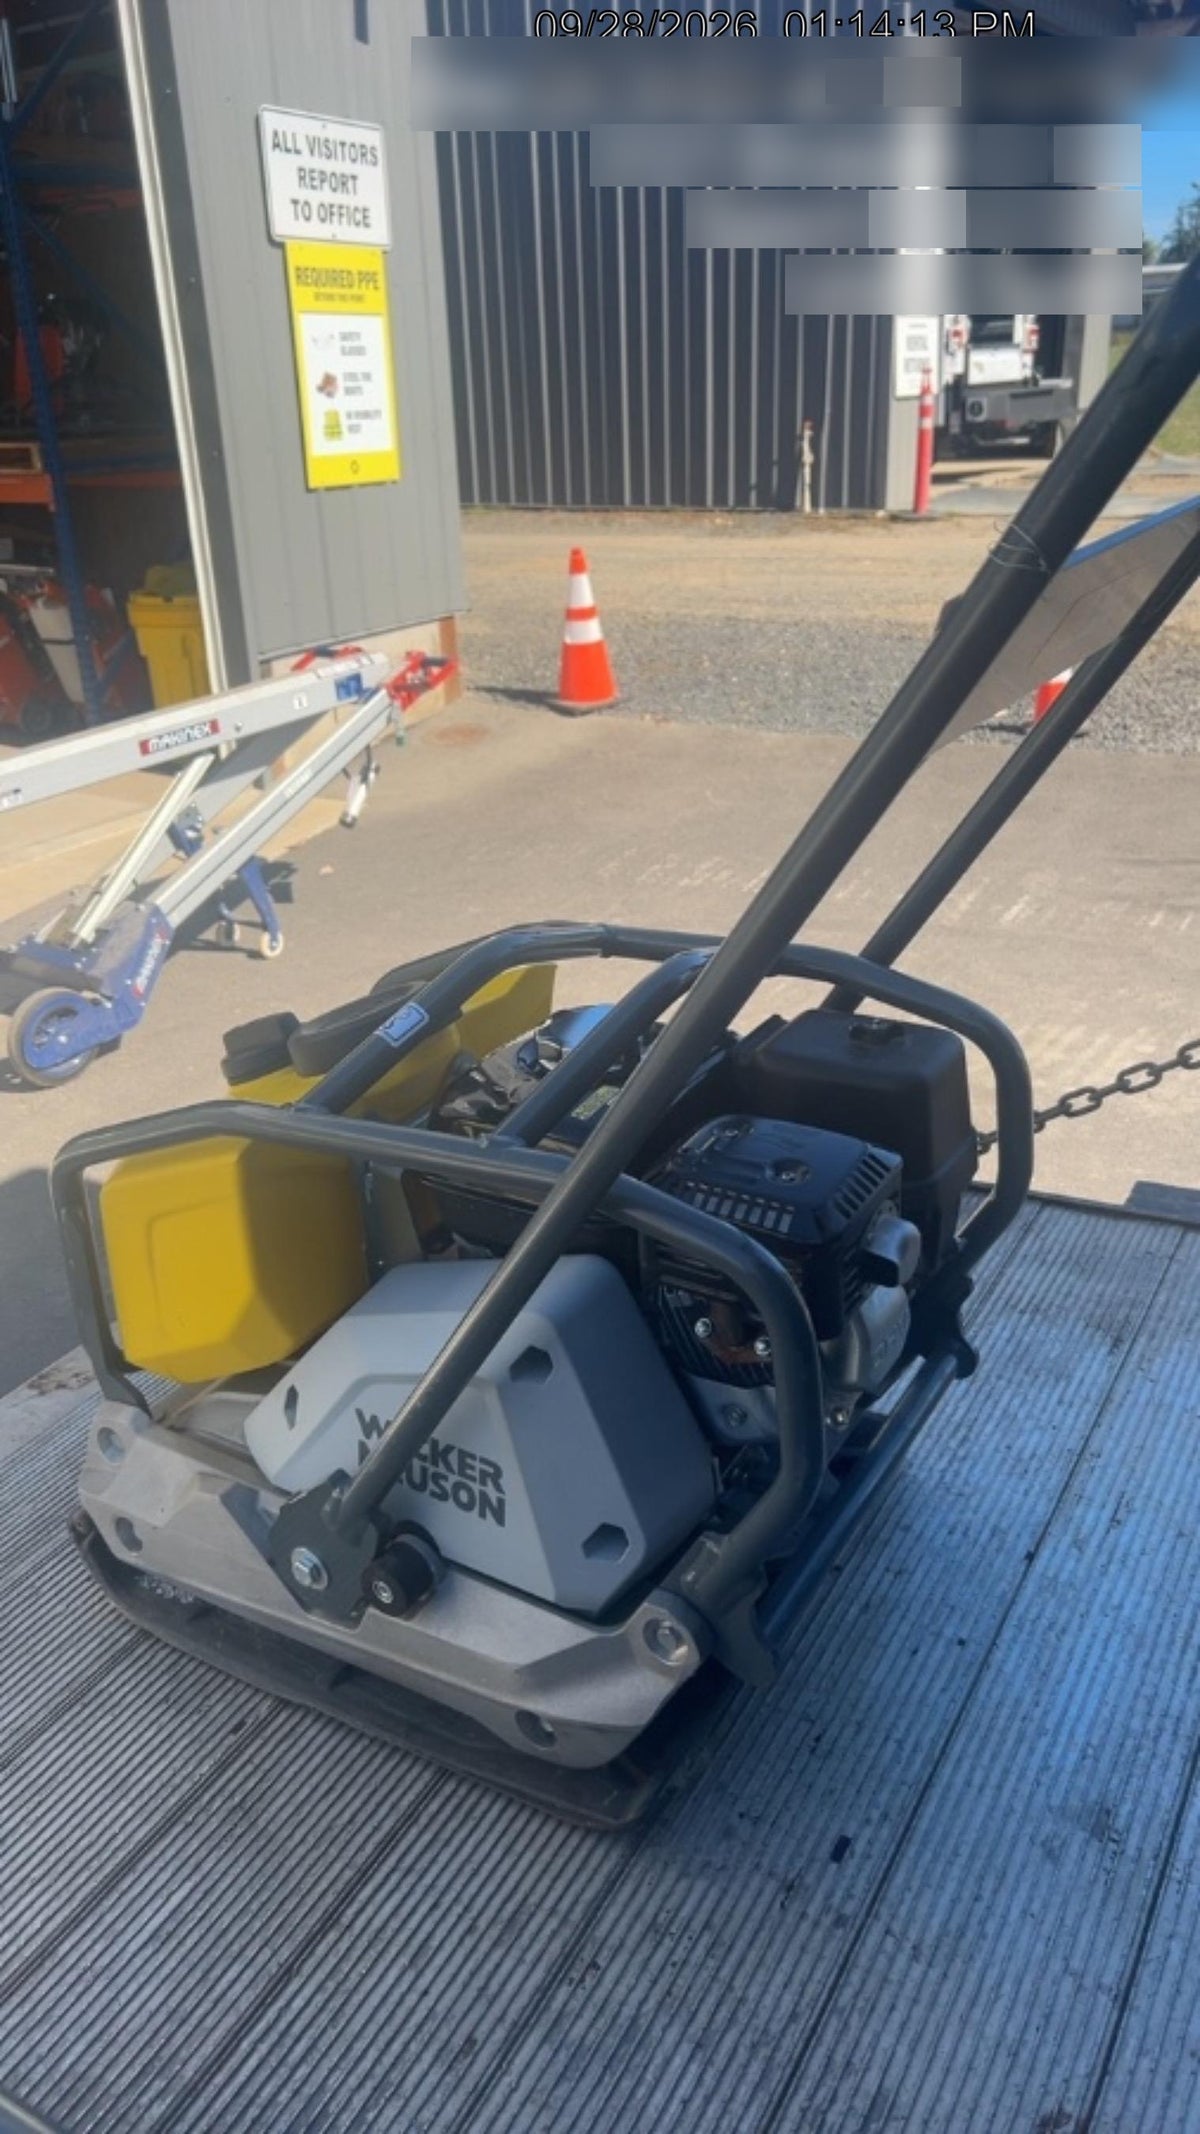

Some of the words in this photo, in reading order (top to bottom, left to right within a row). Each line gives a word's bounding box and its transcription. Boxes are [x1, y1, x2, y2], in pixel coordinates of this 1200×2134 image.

[272, 129, 302, 155] ALL
[305, 134, 378, 167] VISITORS
[297, 166, 358, 196] REPORT
[290, 198, 312, 222] TO
[317, 203, 371, 228] OFFICE
[357, 270, 380, 291] PPE
[355, 1407, 506, 1495] WKER
